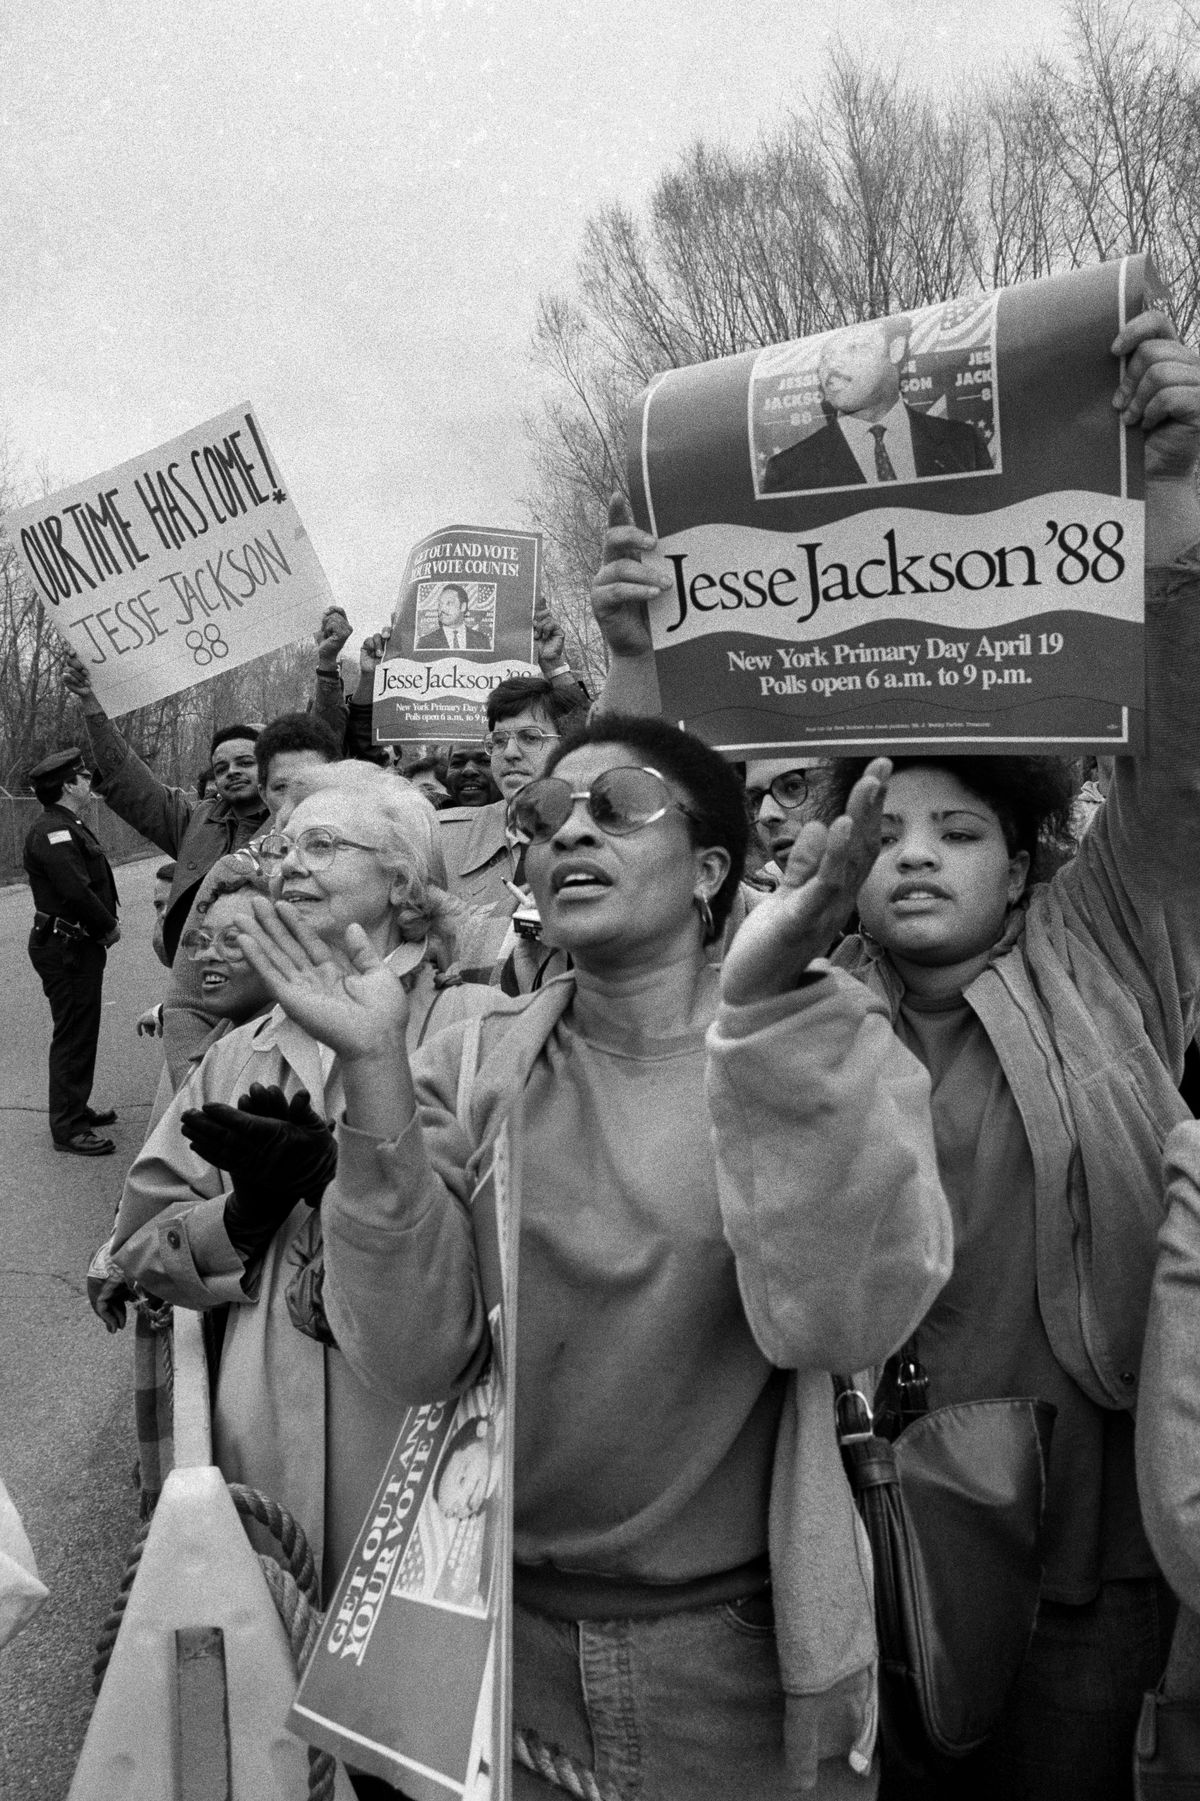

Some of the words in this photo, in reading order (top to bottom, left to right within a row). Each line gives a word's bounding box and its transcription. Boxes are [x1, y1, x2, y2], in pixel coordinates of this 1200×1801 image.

[763, 391, 822, 411] JACKSO
[20, 515, 98, 606] OUR
[62, 488, 150, 582] TIME
[134, 462, 209, 550] HAS
[191, 413, 287, 524] COME!
[429, 543, 453, 558] OUT
[453, 542, 482, 557] AND
[483, 544, 519, 560] VOTE
[432, 559, 463, 574] VOTE
[465, 560, 519, 577] COUNTS!
[69, 589, 169, 664] JESSE
[159, 529, 292, 625] JACKSON
[185, 623, 229, 665] 88
[727, 648, 774, 672] New
[776, 643, 829, 669] York
[833, 640, 922, 667] Primary
[925, 637, 972, 665] Day
[975, 634, 1032, 663] April
[1037, 632, 1064, 654] 19
[759, 672, 807, 696] Polls
[810, 674, 862, 697] open
[865, 669, 881, 688] 6
[883, 671, 933, 689] a.m.
[937, 667, 960, 687] to
[962, 665, 977, 685] 9
[979, 668, 1033, 692] p.m.
[396, 703, 411, 711] New
[413, 702, 429, 711] York
[431, 703, 460, 713] Primary
[462, 703, 477, 713] Day
[405, 713, 421, 721] Polls
[422, 713, 440, 722] open
[466, 713, 474, 721] to
[327, 1566, 368, 1654] GET
[362, 1474, 403, 1561] OUT
[340, 1547, 397, 1660] YOUR
[386, 1437, 434, 1541] VOTE
